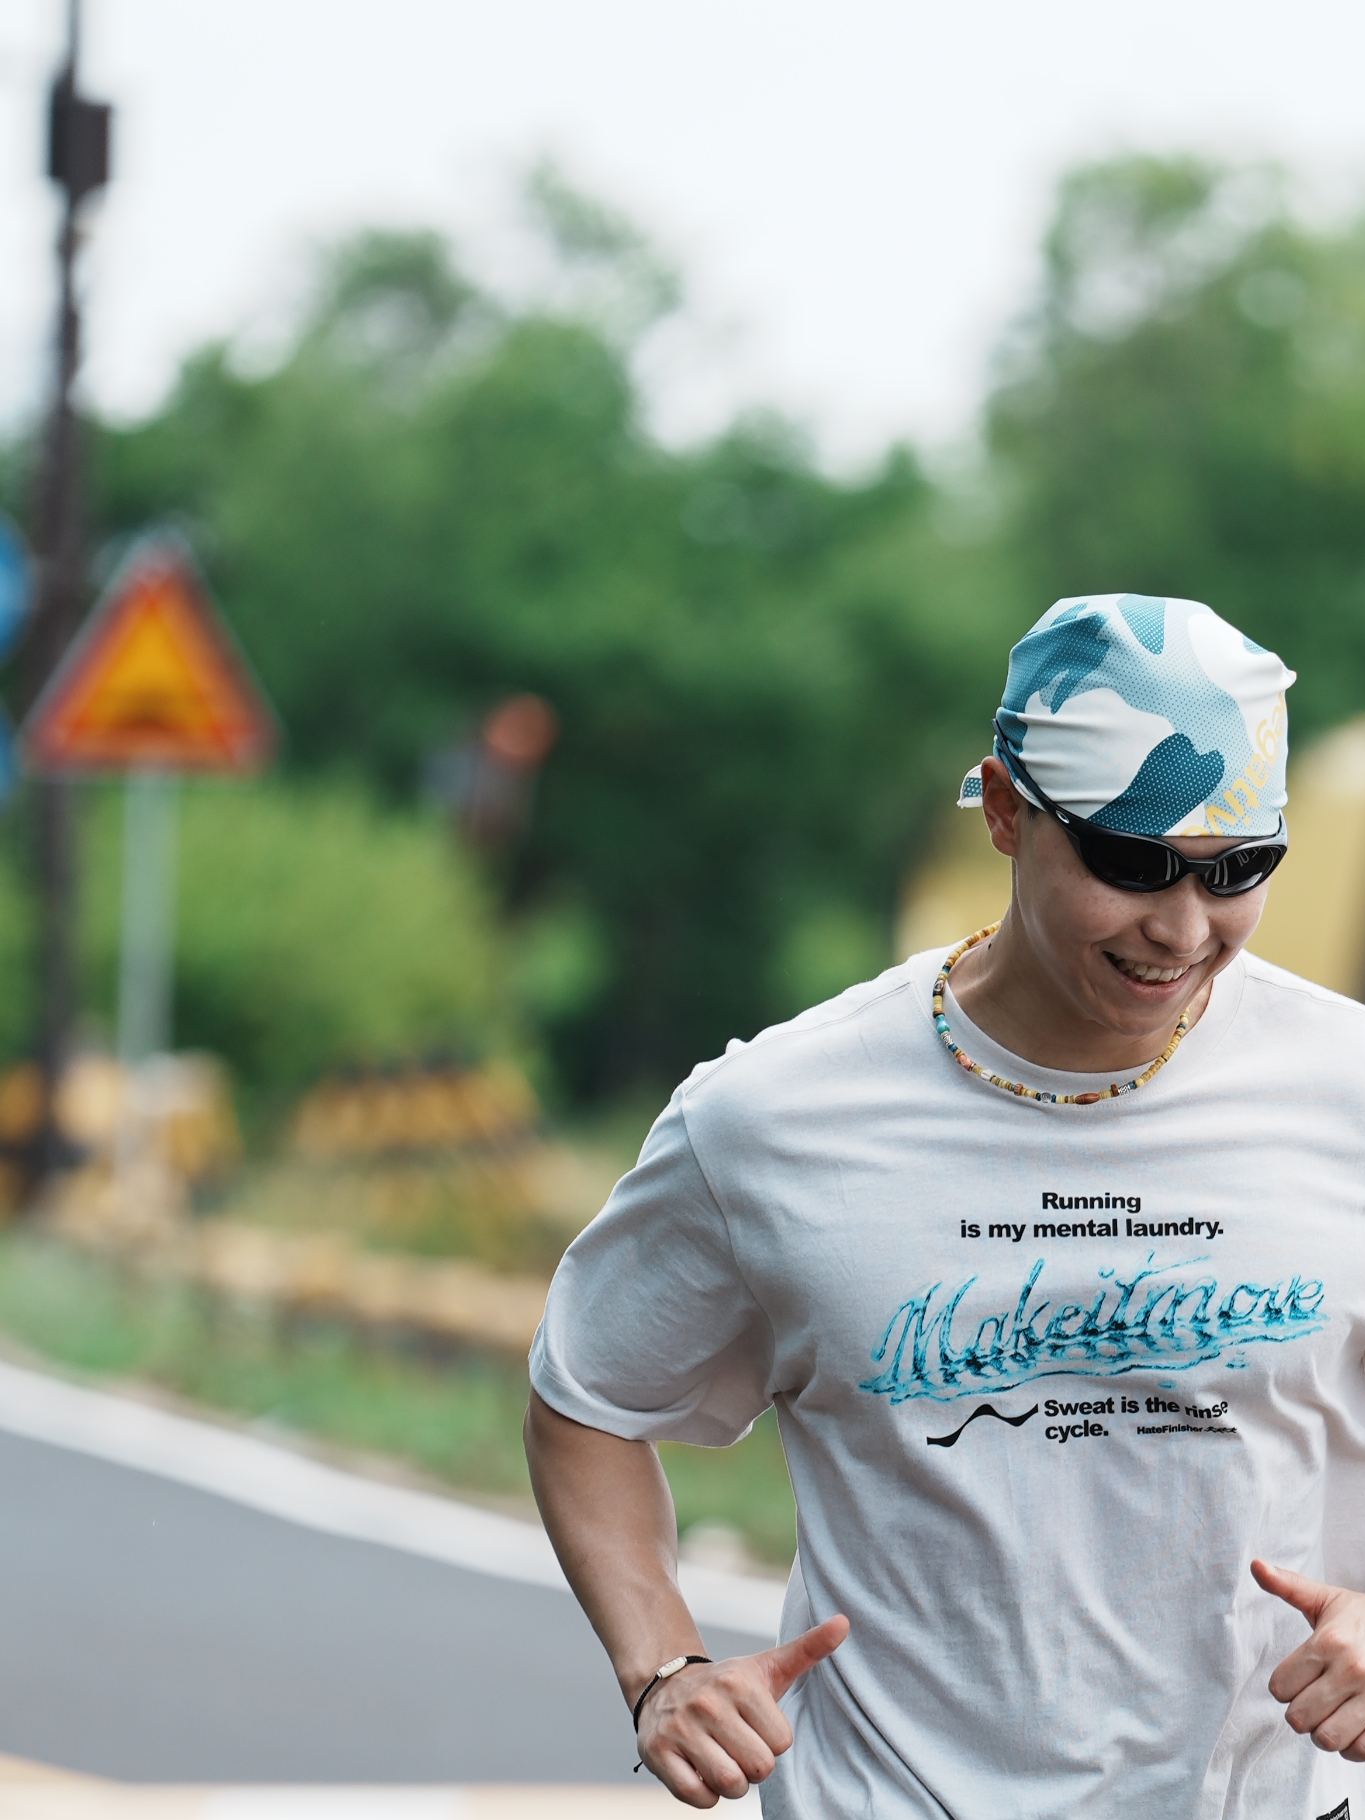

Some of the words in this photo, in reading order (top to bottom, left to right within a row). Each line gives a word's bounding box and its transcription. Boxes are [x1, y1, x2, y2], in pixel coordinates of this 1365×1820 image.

[1042, 1192, 1141, 1212] Running
[961, 1219, 981, 1238] is
[988, 1223, 1027, 1242] my
[1034, 1219, 1118, 1238] mental
[1126, 1217, 1224, 1240] laundry.
[861, 1250, 1326, 1400] Makeitmove
[1044, 1397, 1115, 1417] Sweat
[1121, 1396, 1139, 1414] is
[1145, 1396, 1180, 1414] the
[1184, 1401, 1229, 1419] rinse
[1045, 1420, 1109, 1442] cycle.
[1136, 1424, 1204, 1435] HateFinisher
